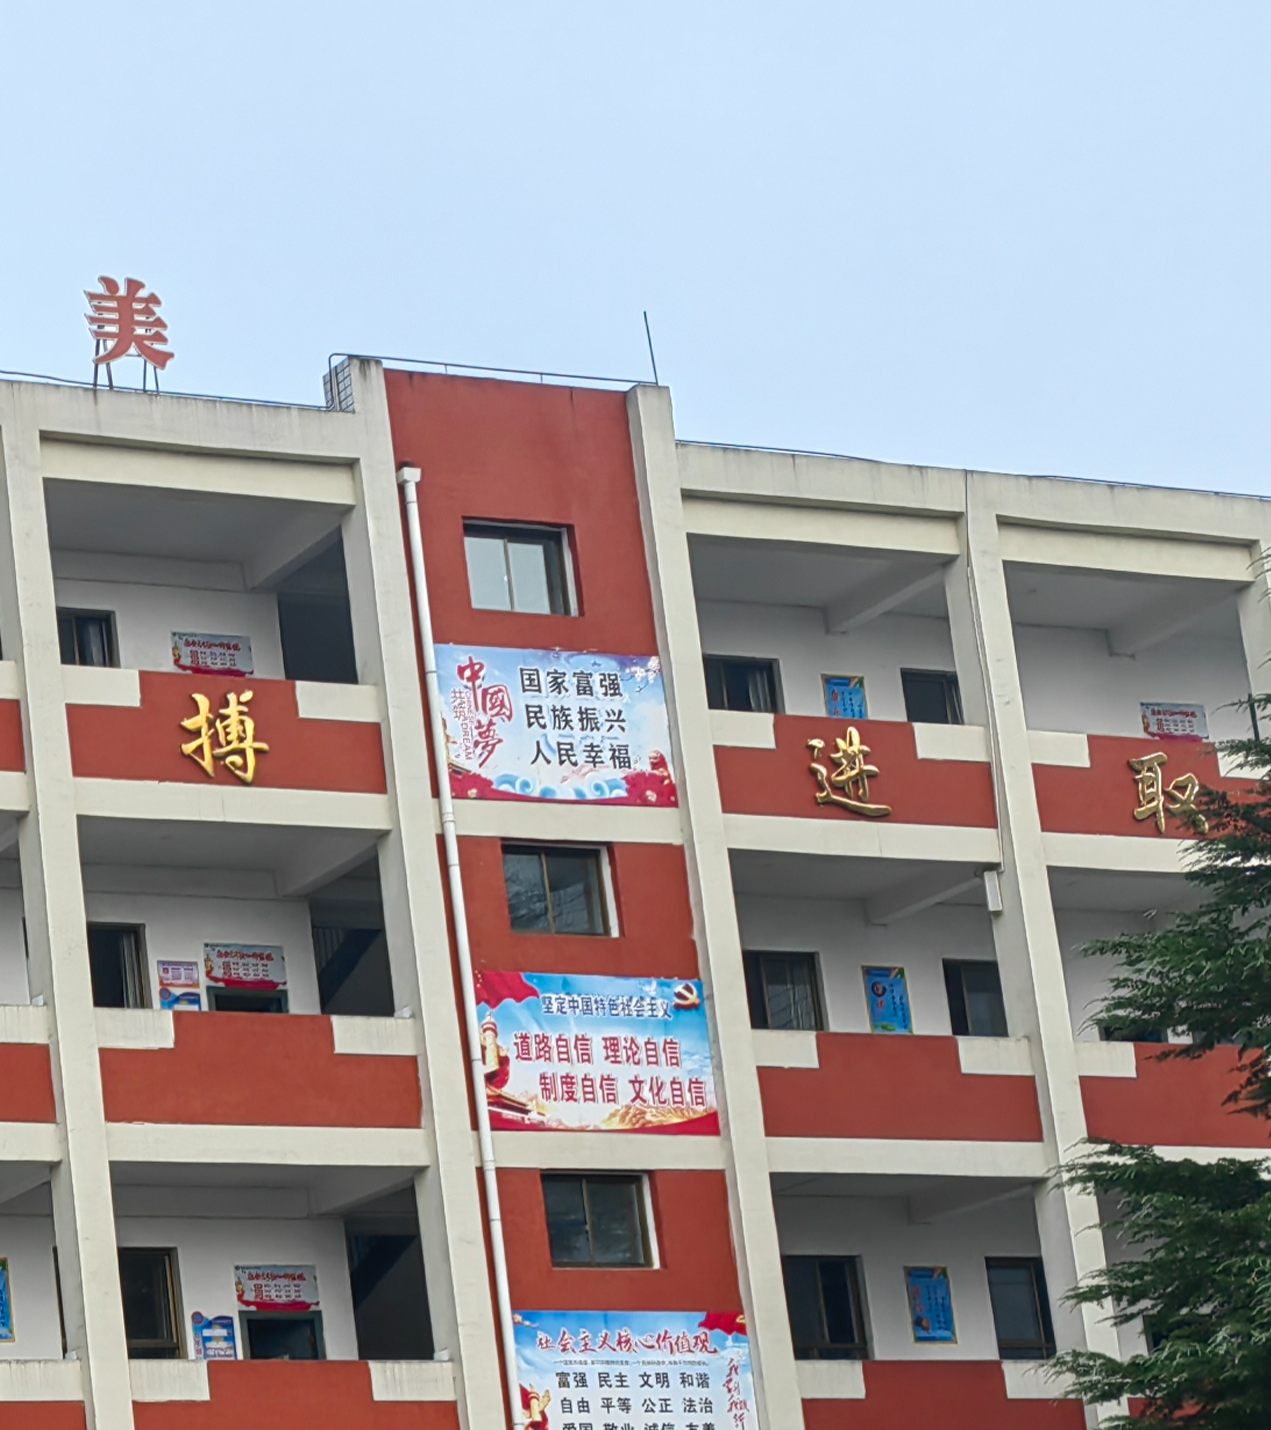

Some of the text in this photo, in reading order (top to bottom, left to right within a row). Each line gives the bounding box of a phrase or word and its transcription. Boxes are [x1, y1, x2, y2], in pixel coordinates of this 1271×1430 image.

[519, 666, 623, 698] 国家富强
[525, 703, 626, 734] 民族振兴
[179, 689, 269, 787] 搏
[530, 740, 632, 770] 人民幸福
[806, 726, 893, 818] 进
[1128, 751, 1209, 834] 取
[541, 994, 672, 1020] 坚定中国特色社会主义
[513, 1032, 682, 1068] 道路自信 理论自信
[539, 1072, 706, 1107] 制度自信 文化自信
[536, 1326, 720, 1357] 社会主义核心价值观
[556, 1371, 711, 1389] 富强 民主 文明 和谐
[560, 1397, 714, 1415] 自由 平等 公正 法治
